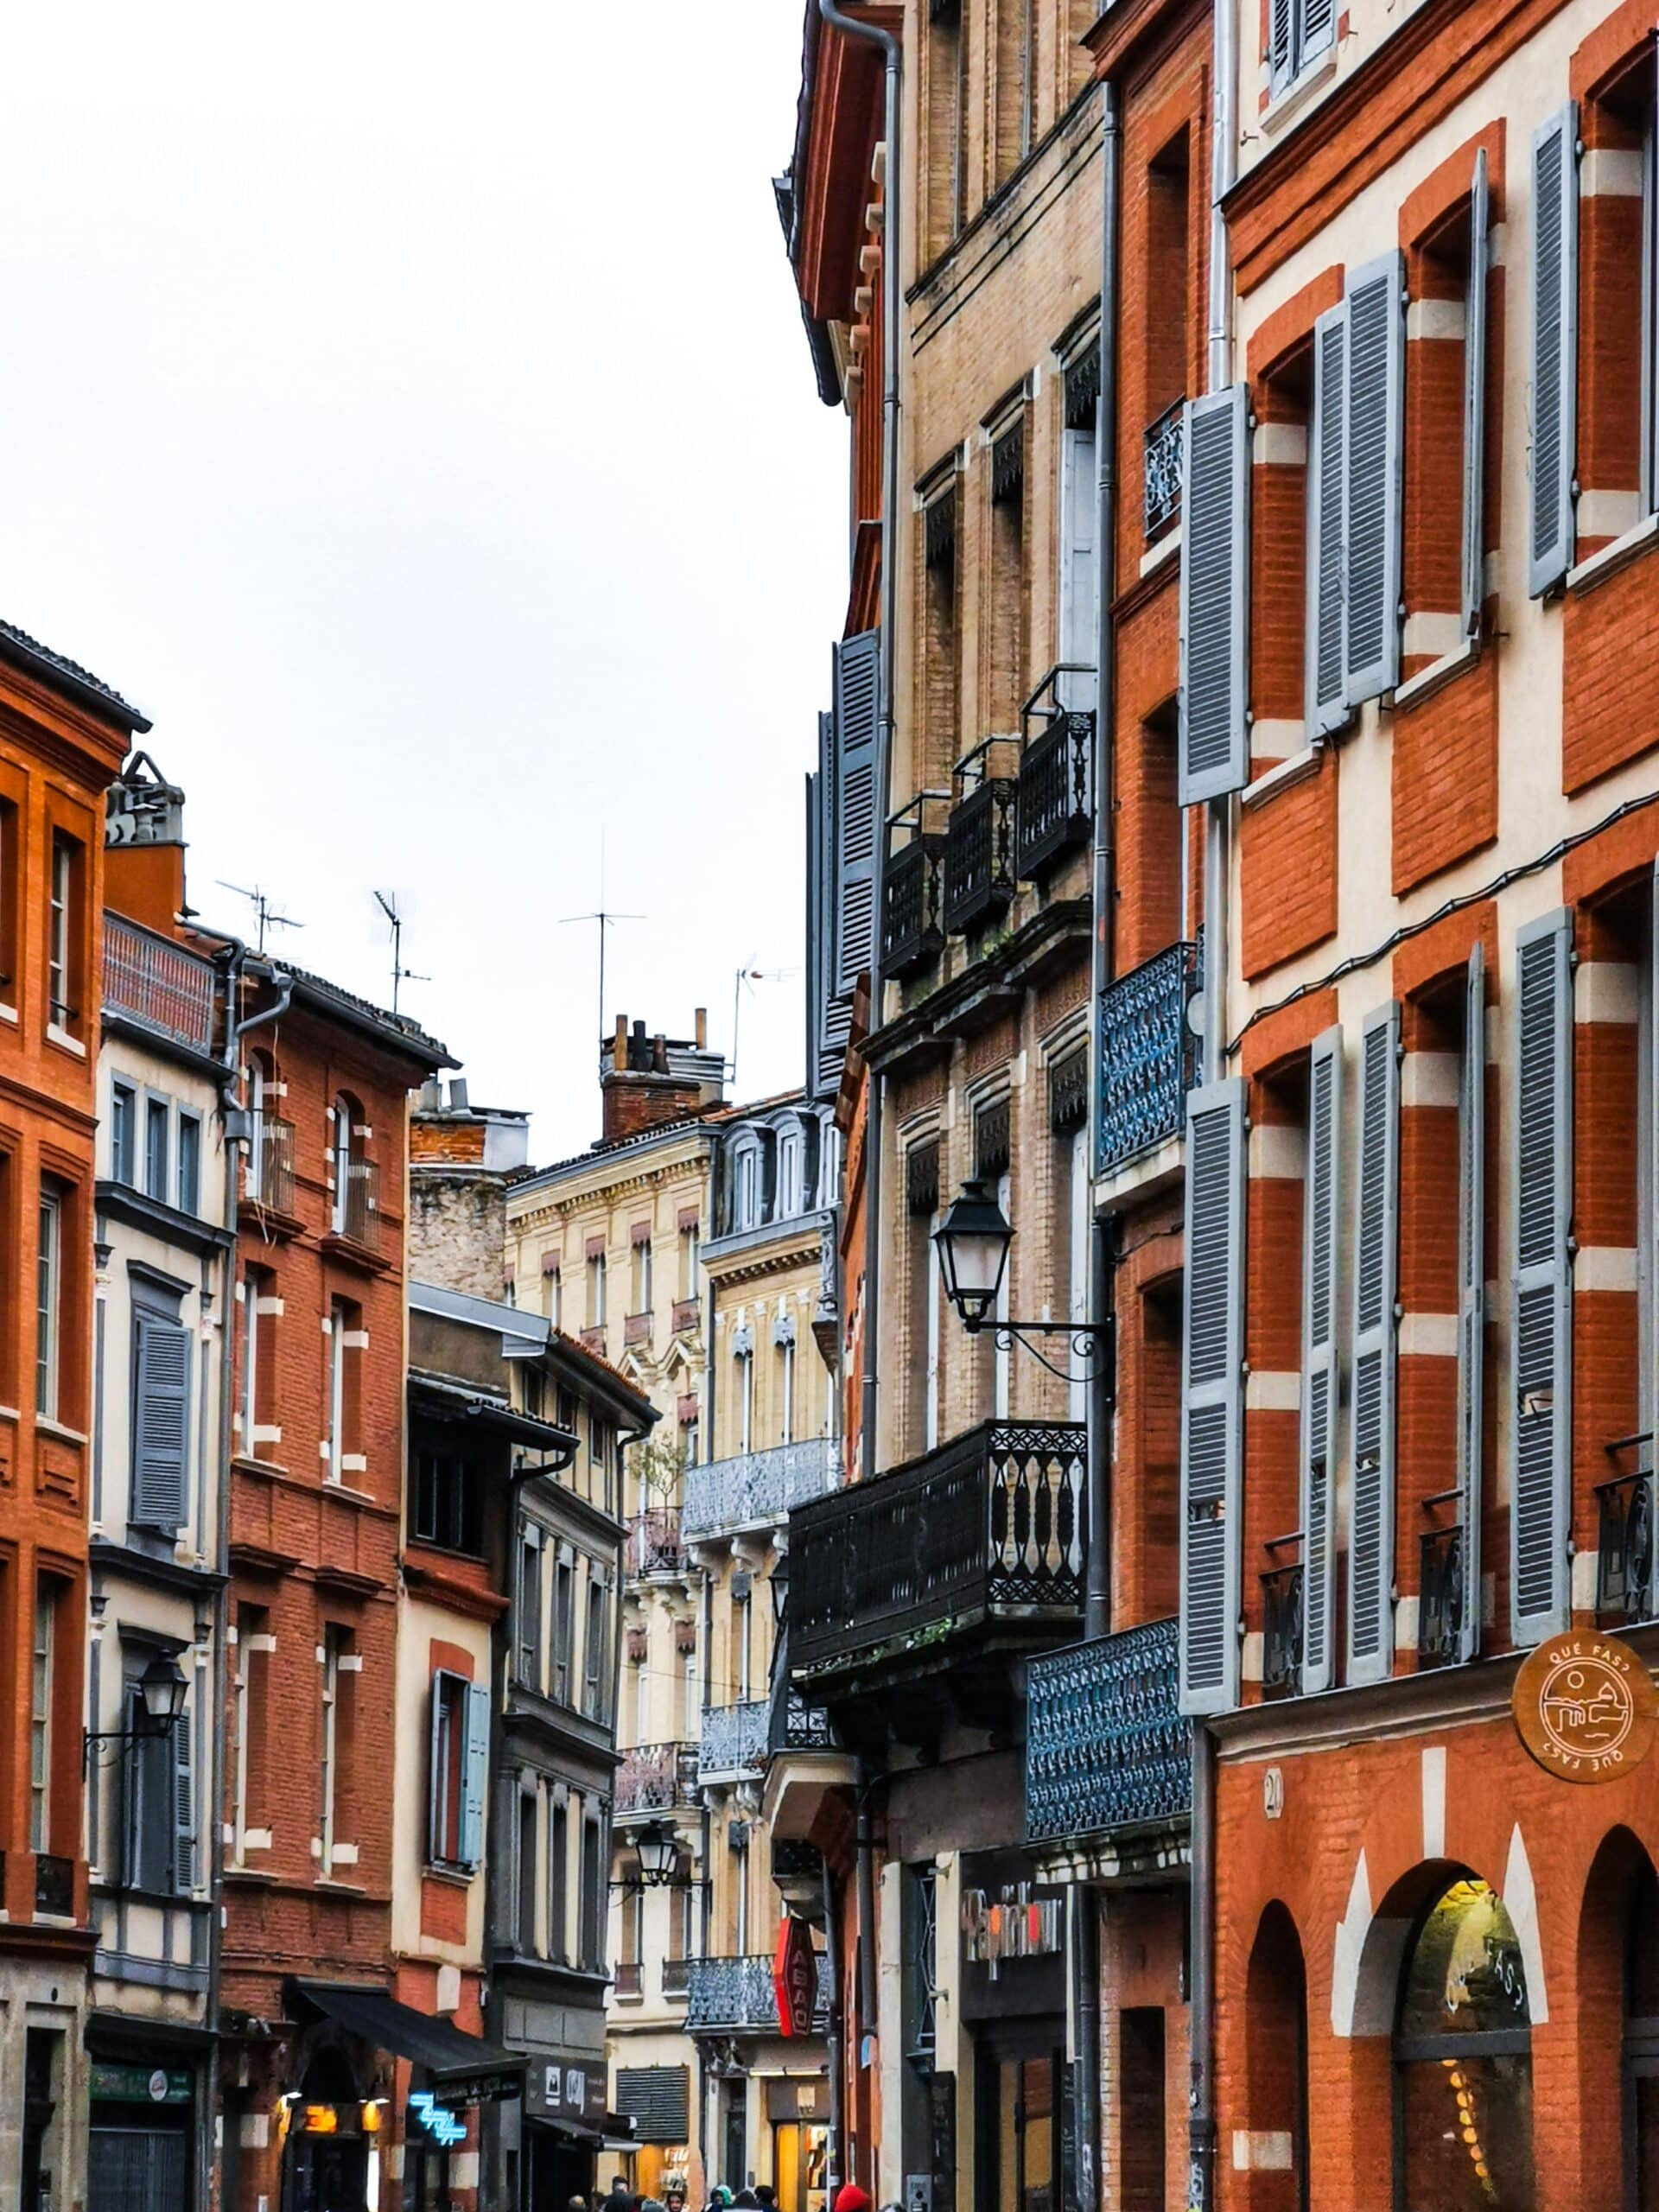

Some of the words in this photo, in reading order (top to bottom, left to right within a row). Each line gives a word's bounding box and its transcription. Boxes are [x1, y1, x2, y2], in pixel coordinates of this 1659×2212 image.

[1549, 1643, 1581, 1664] QUÉ
[1592, 1645, 1630, 1672] FAS?
[1266, 1774, 1282, 1810] 20
